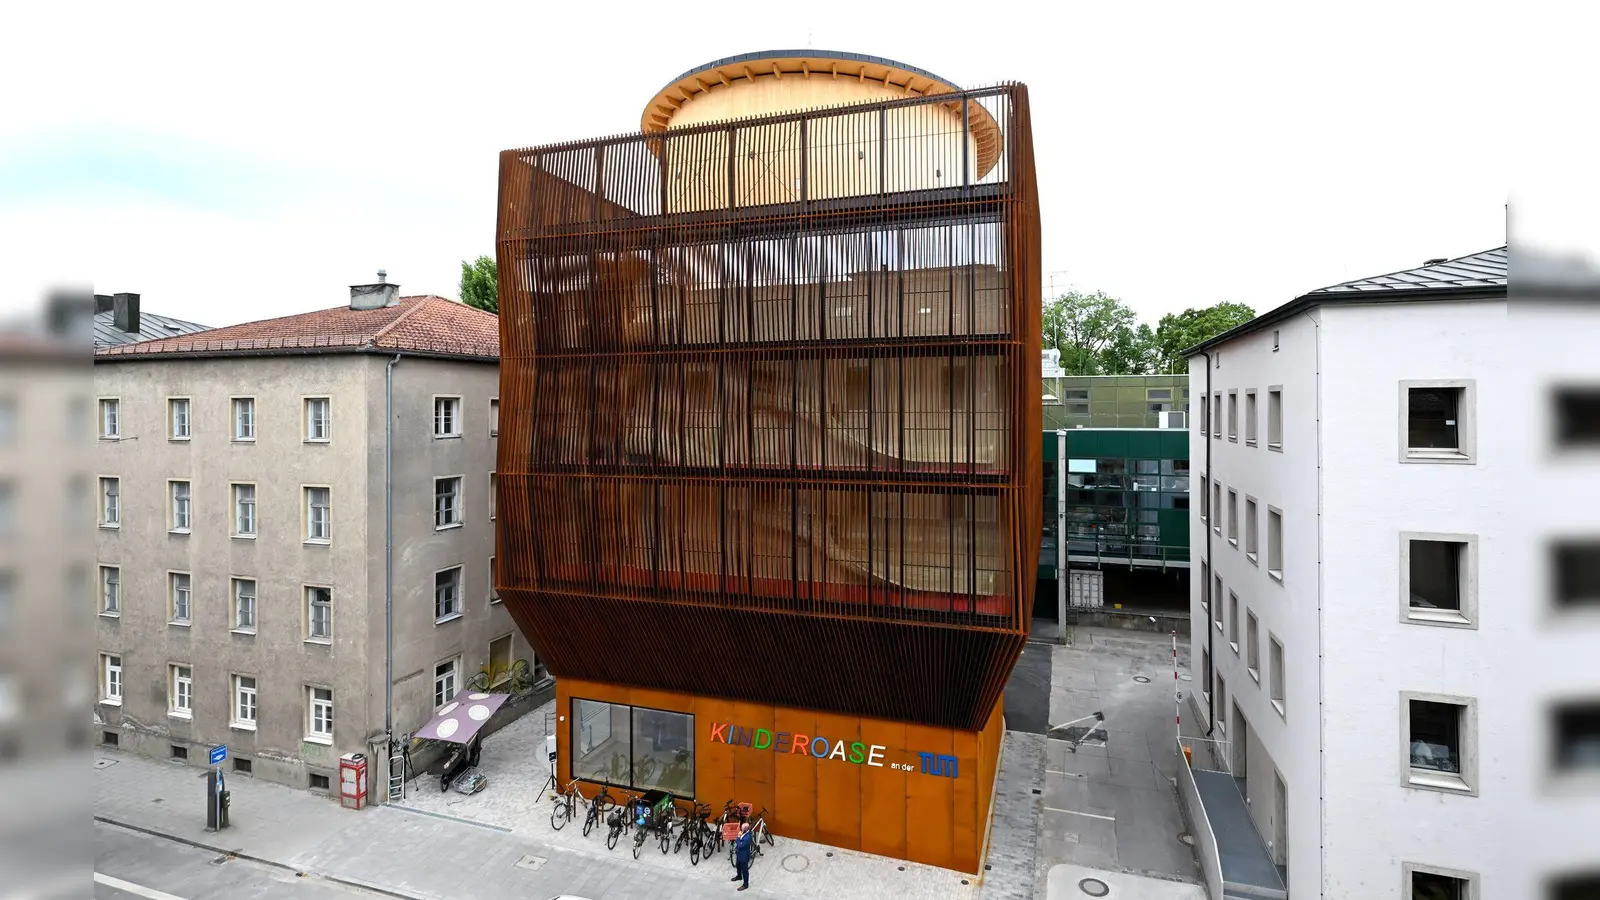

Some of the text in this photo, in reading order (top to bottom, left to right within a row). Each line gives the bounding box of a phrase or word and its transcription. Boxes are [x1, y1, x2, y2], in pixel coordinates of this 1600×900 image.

[710, 722, 959, 779] KINDEROASE an der TUM
